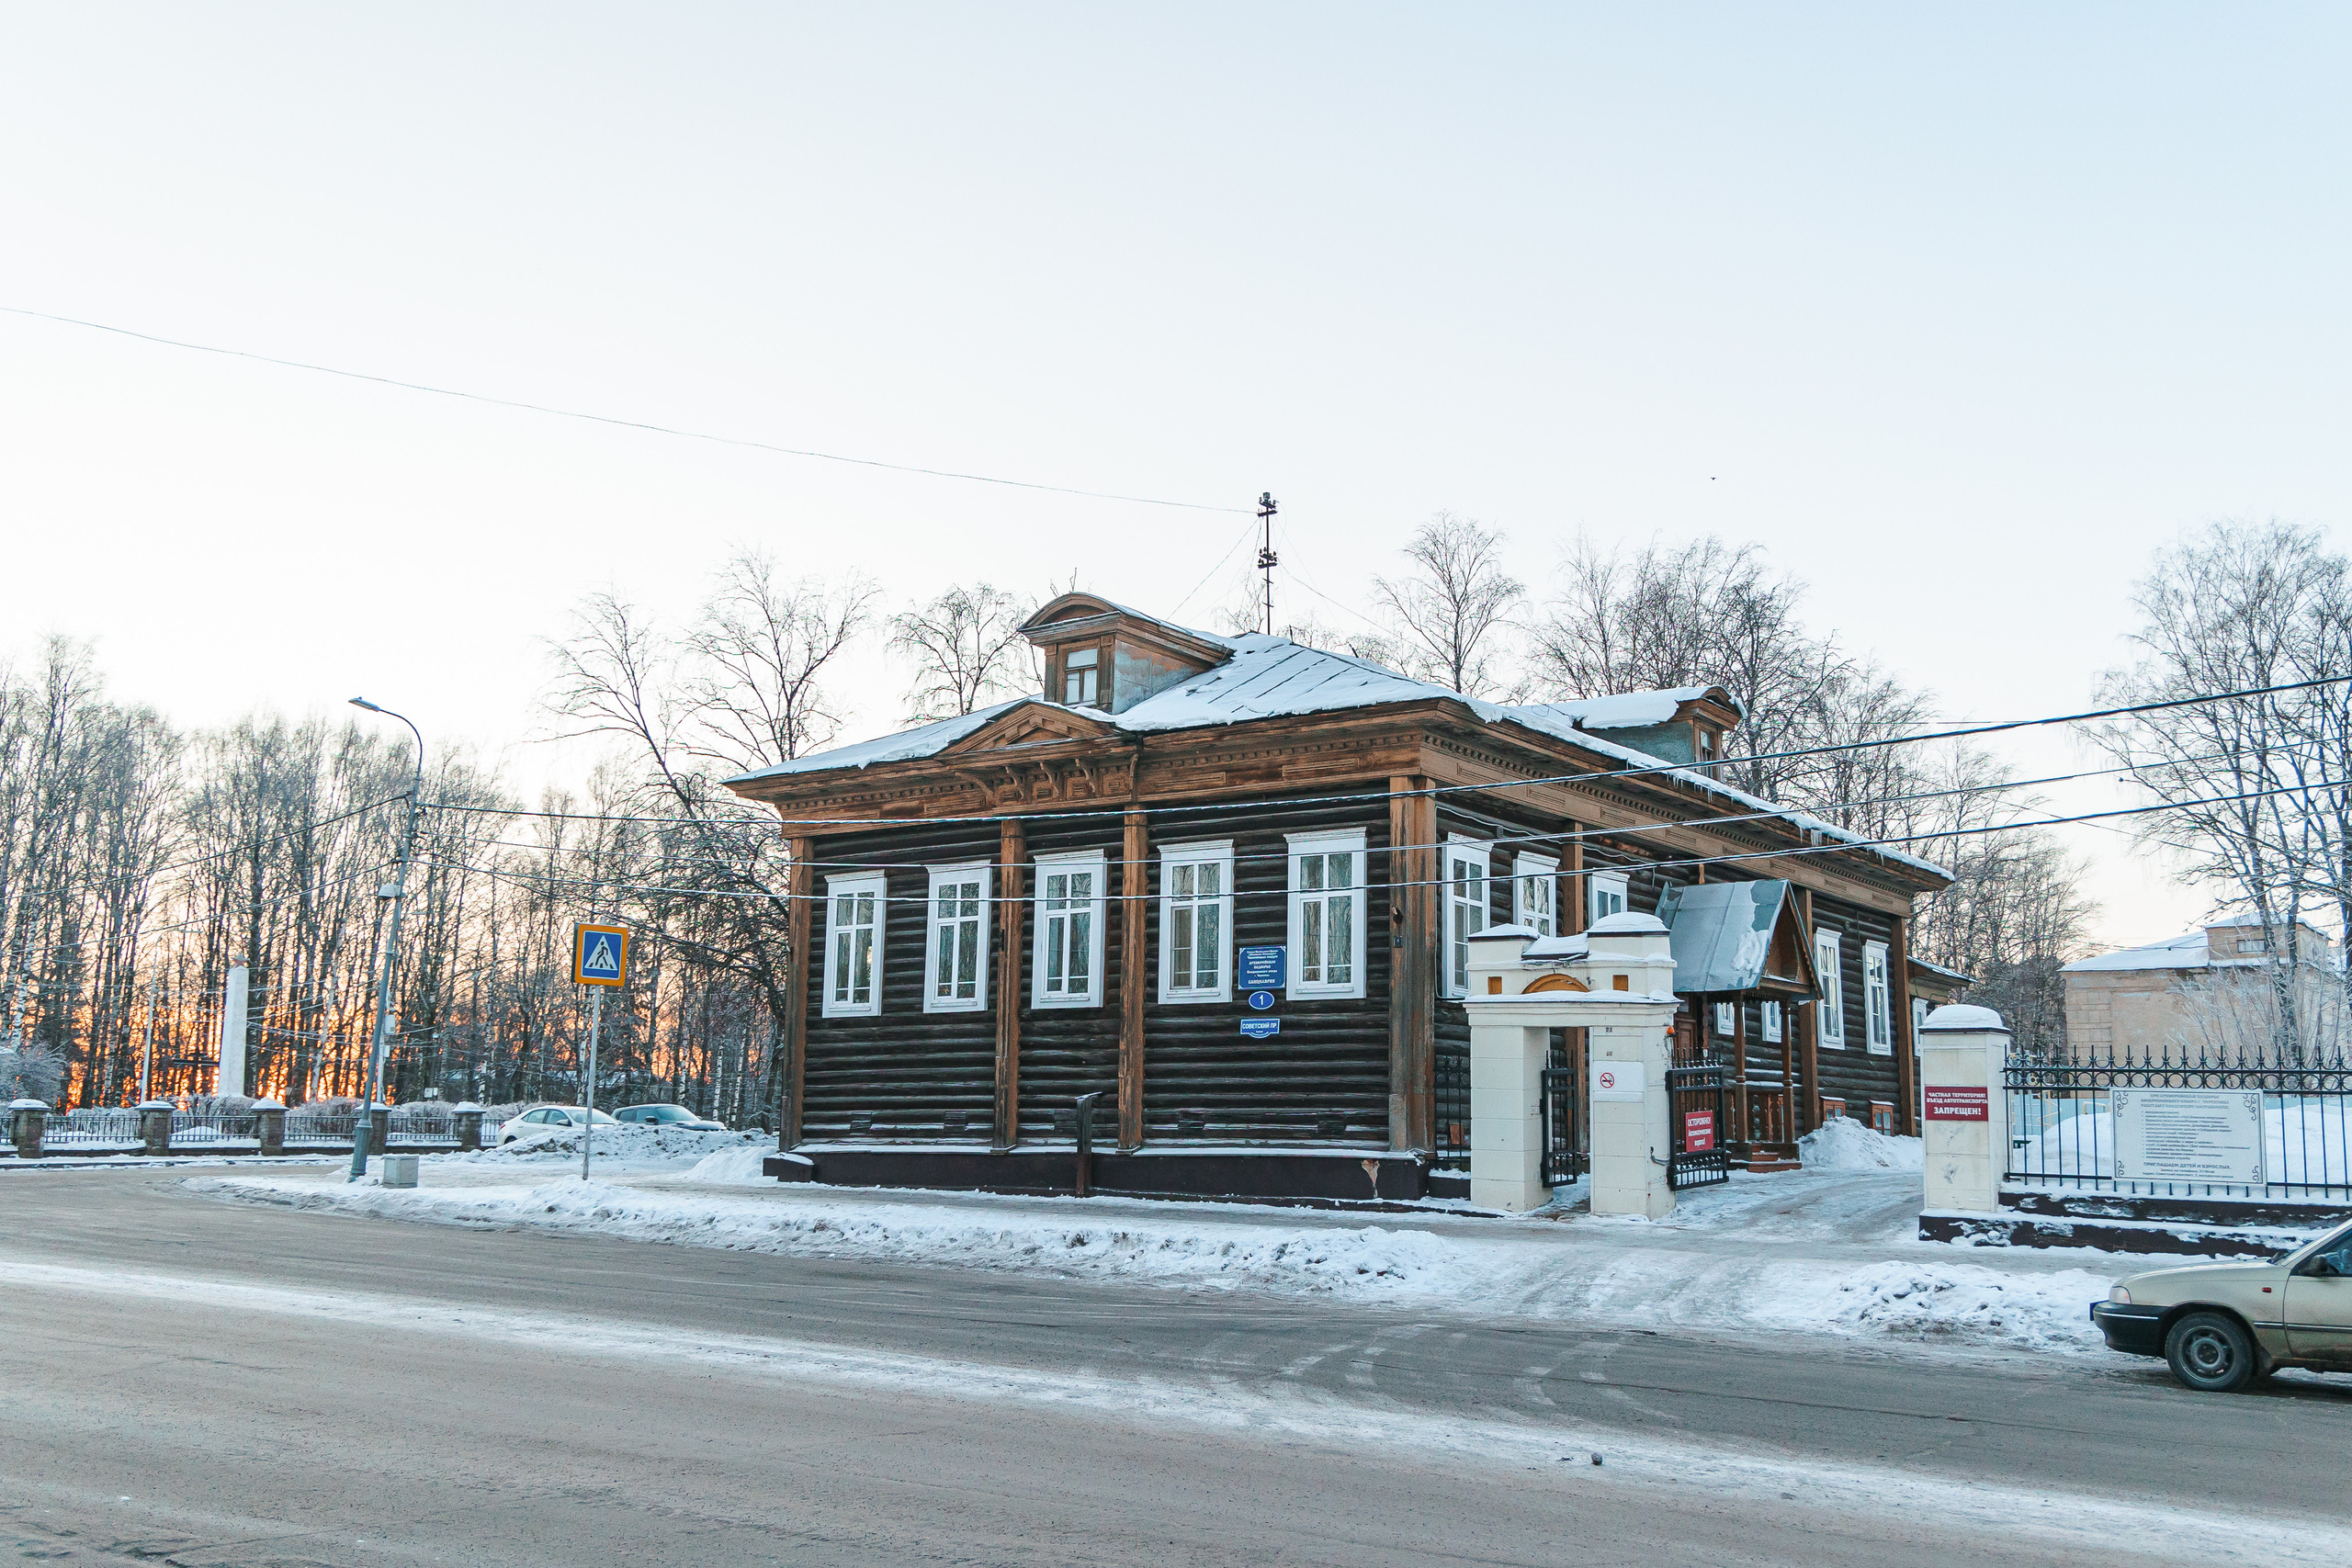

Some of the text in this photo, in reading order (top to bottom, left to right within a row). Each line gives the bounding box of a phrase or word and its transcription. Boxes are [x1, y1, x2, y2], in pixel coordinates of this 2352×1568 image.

[1259, 994, 1263, 1006] 1
[1933, 1107, 1982, 1116] ЗАПРЕЩЕН!
[1688, 1116, 1711, 1126] ОСТОРОЖНО!
